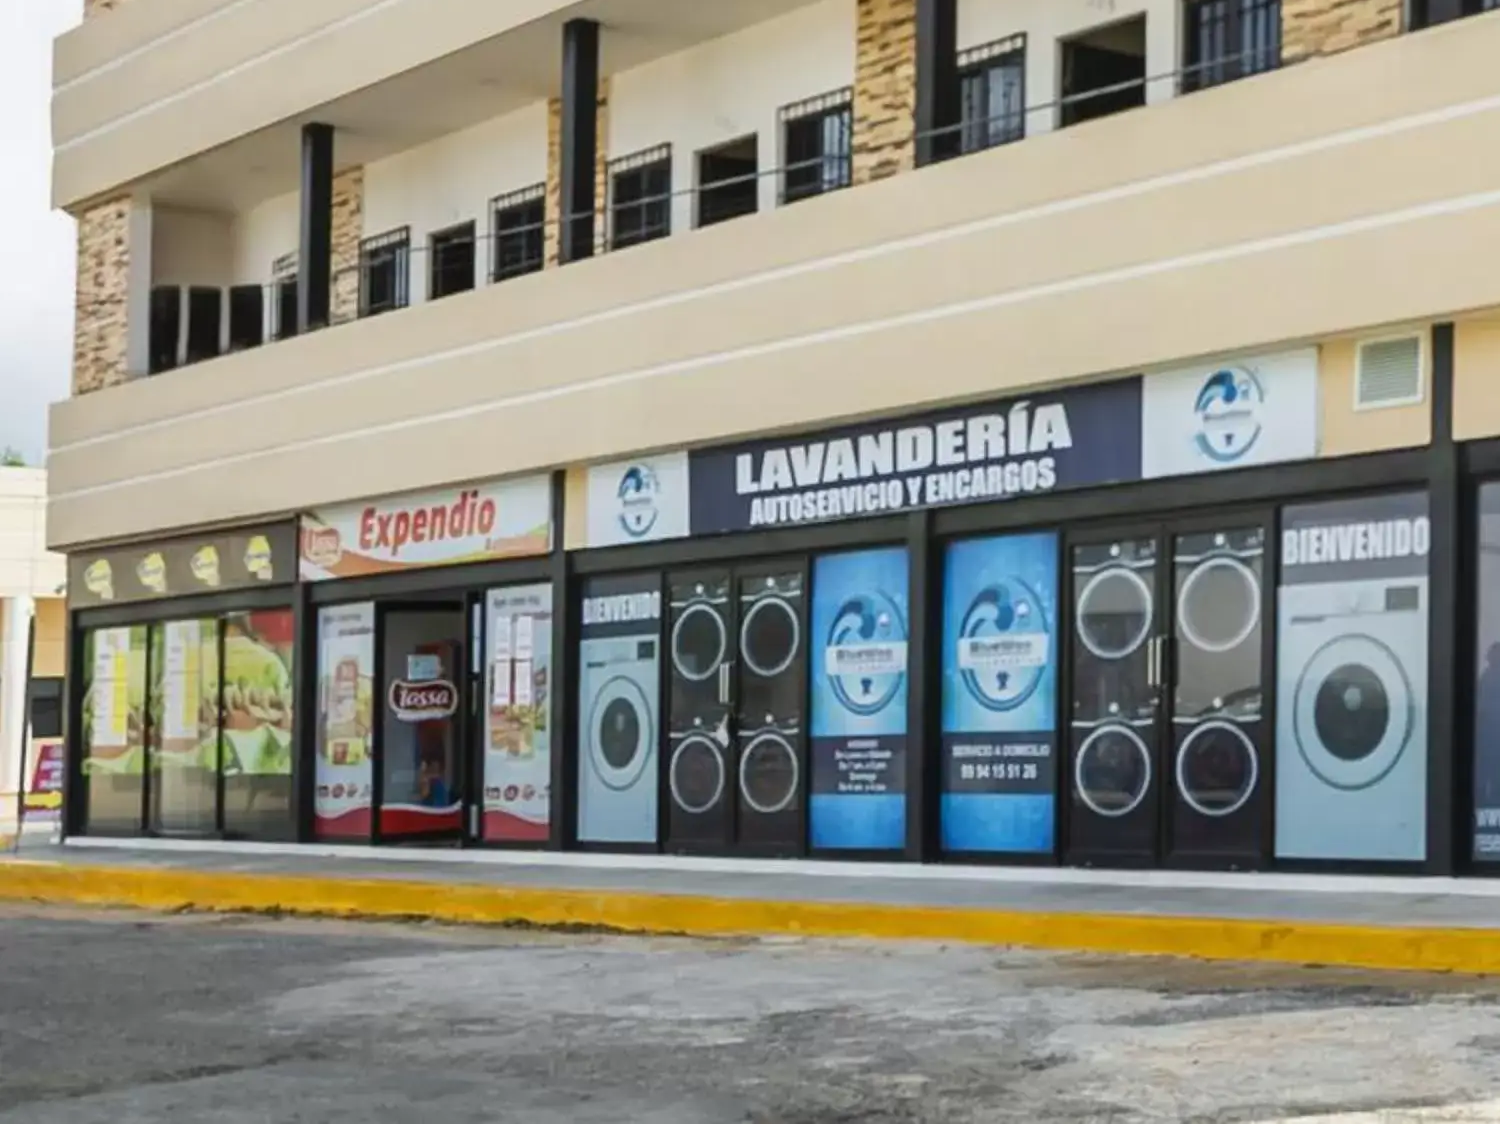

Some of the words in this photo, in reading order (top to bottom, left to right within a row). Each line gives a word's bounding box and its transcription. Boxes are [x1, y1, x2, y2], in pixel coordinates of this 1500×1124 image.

[736, 401, 1073, 494] LAVANDERÍA
[358, 490, 496, 557] Expendio
[750, 480, 905, 526] AUTOSERVICIO
[905, 477, 926, 506] Y
[926, 458, 1056, 505] ENCARGOS
[1283, 516, 1430, 566] BIENVENIDO
